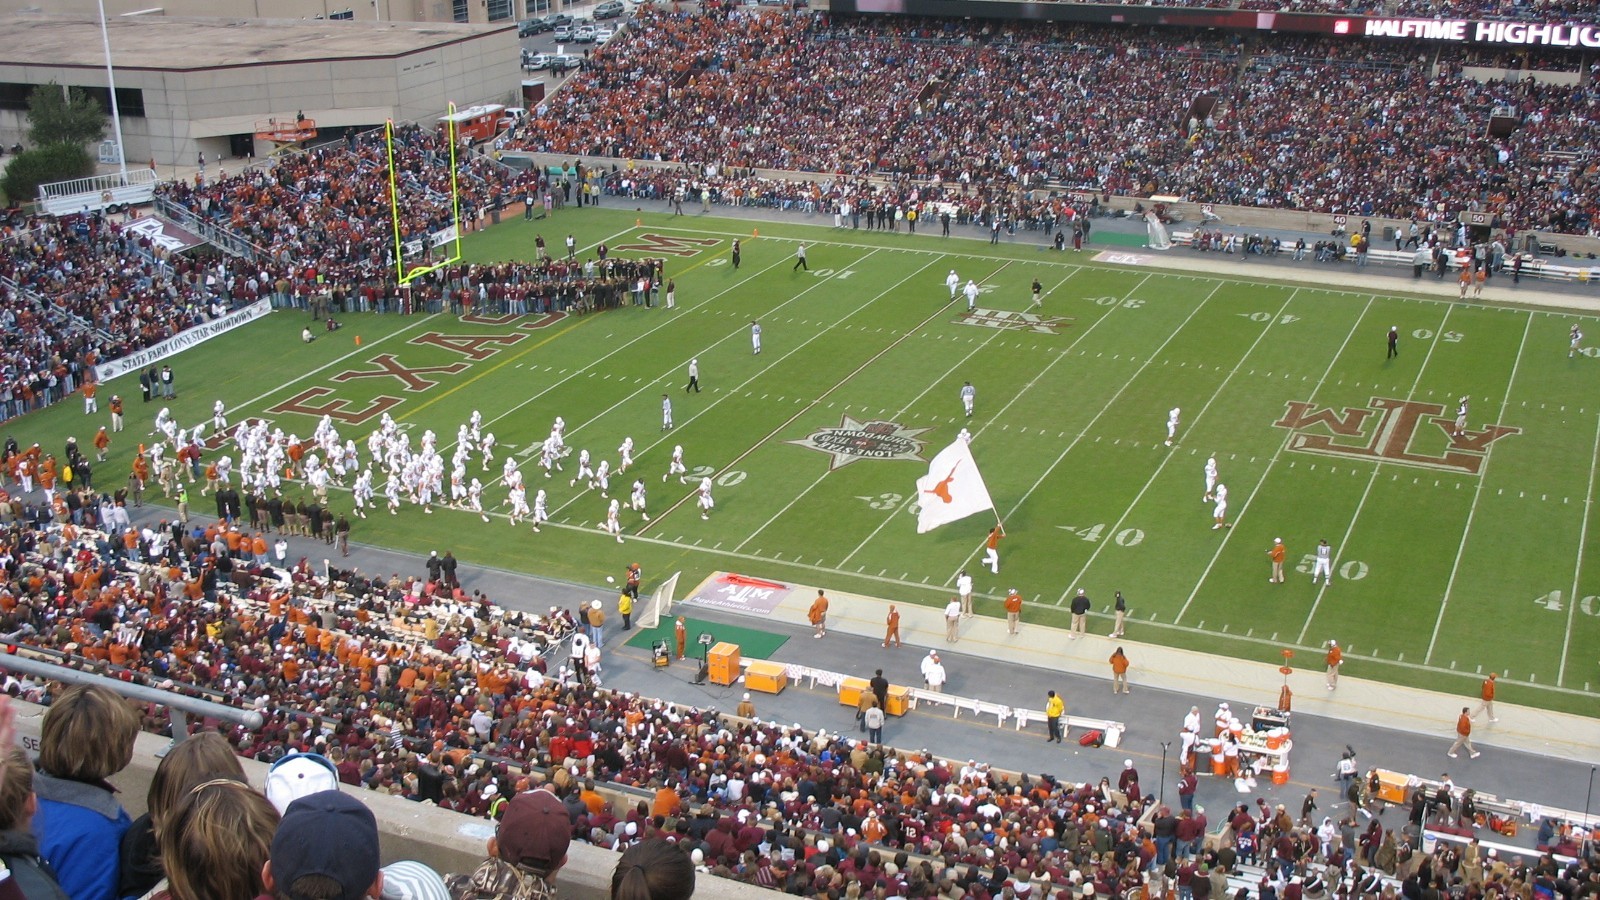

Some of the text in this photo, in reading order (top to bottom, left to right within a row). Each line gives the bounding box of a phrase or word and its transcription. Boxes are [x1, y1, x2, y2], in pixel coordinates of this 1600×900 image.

[1364, 20, 1467, 41] HALFTIME
[1333, 215, 1346, 225] 40
[1472, 214, 1484, 223] 50
[122, 309, 253, 372] STATE FARM LONE STAR SHOWDOWN
[833, 429, 911, 445] SHOWDOWN
[818, 441, 893, 457] LONE STAR
[683, 465, 748, 487] 20
[1076, 523, 1145, 547] 40
[1295, 553, 1369, 580] 50
[1533, 589, 1600, 617] 40
[22, 736, 43, 752] SE
